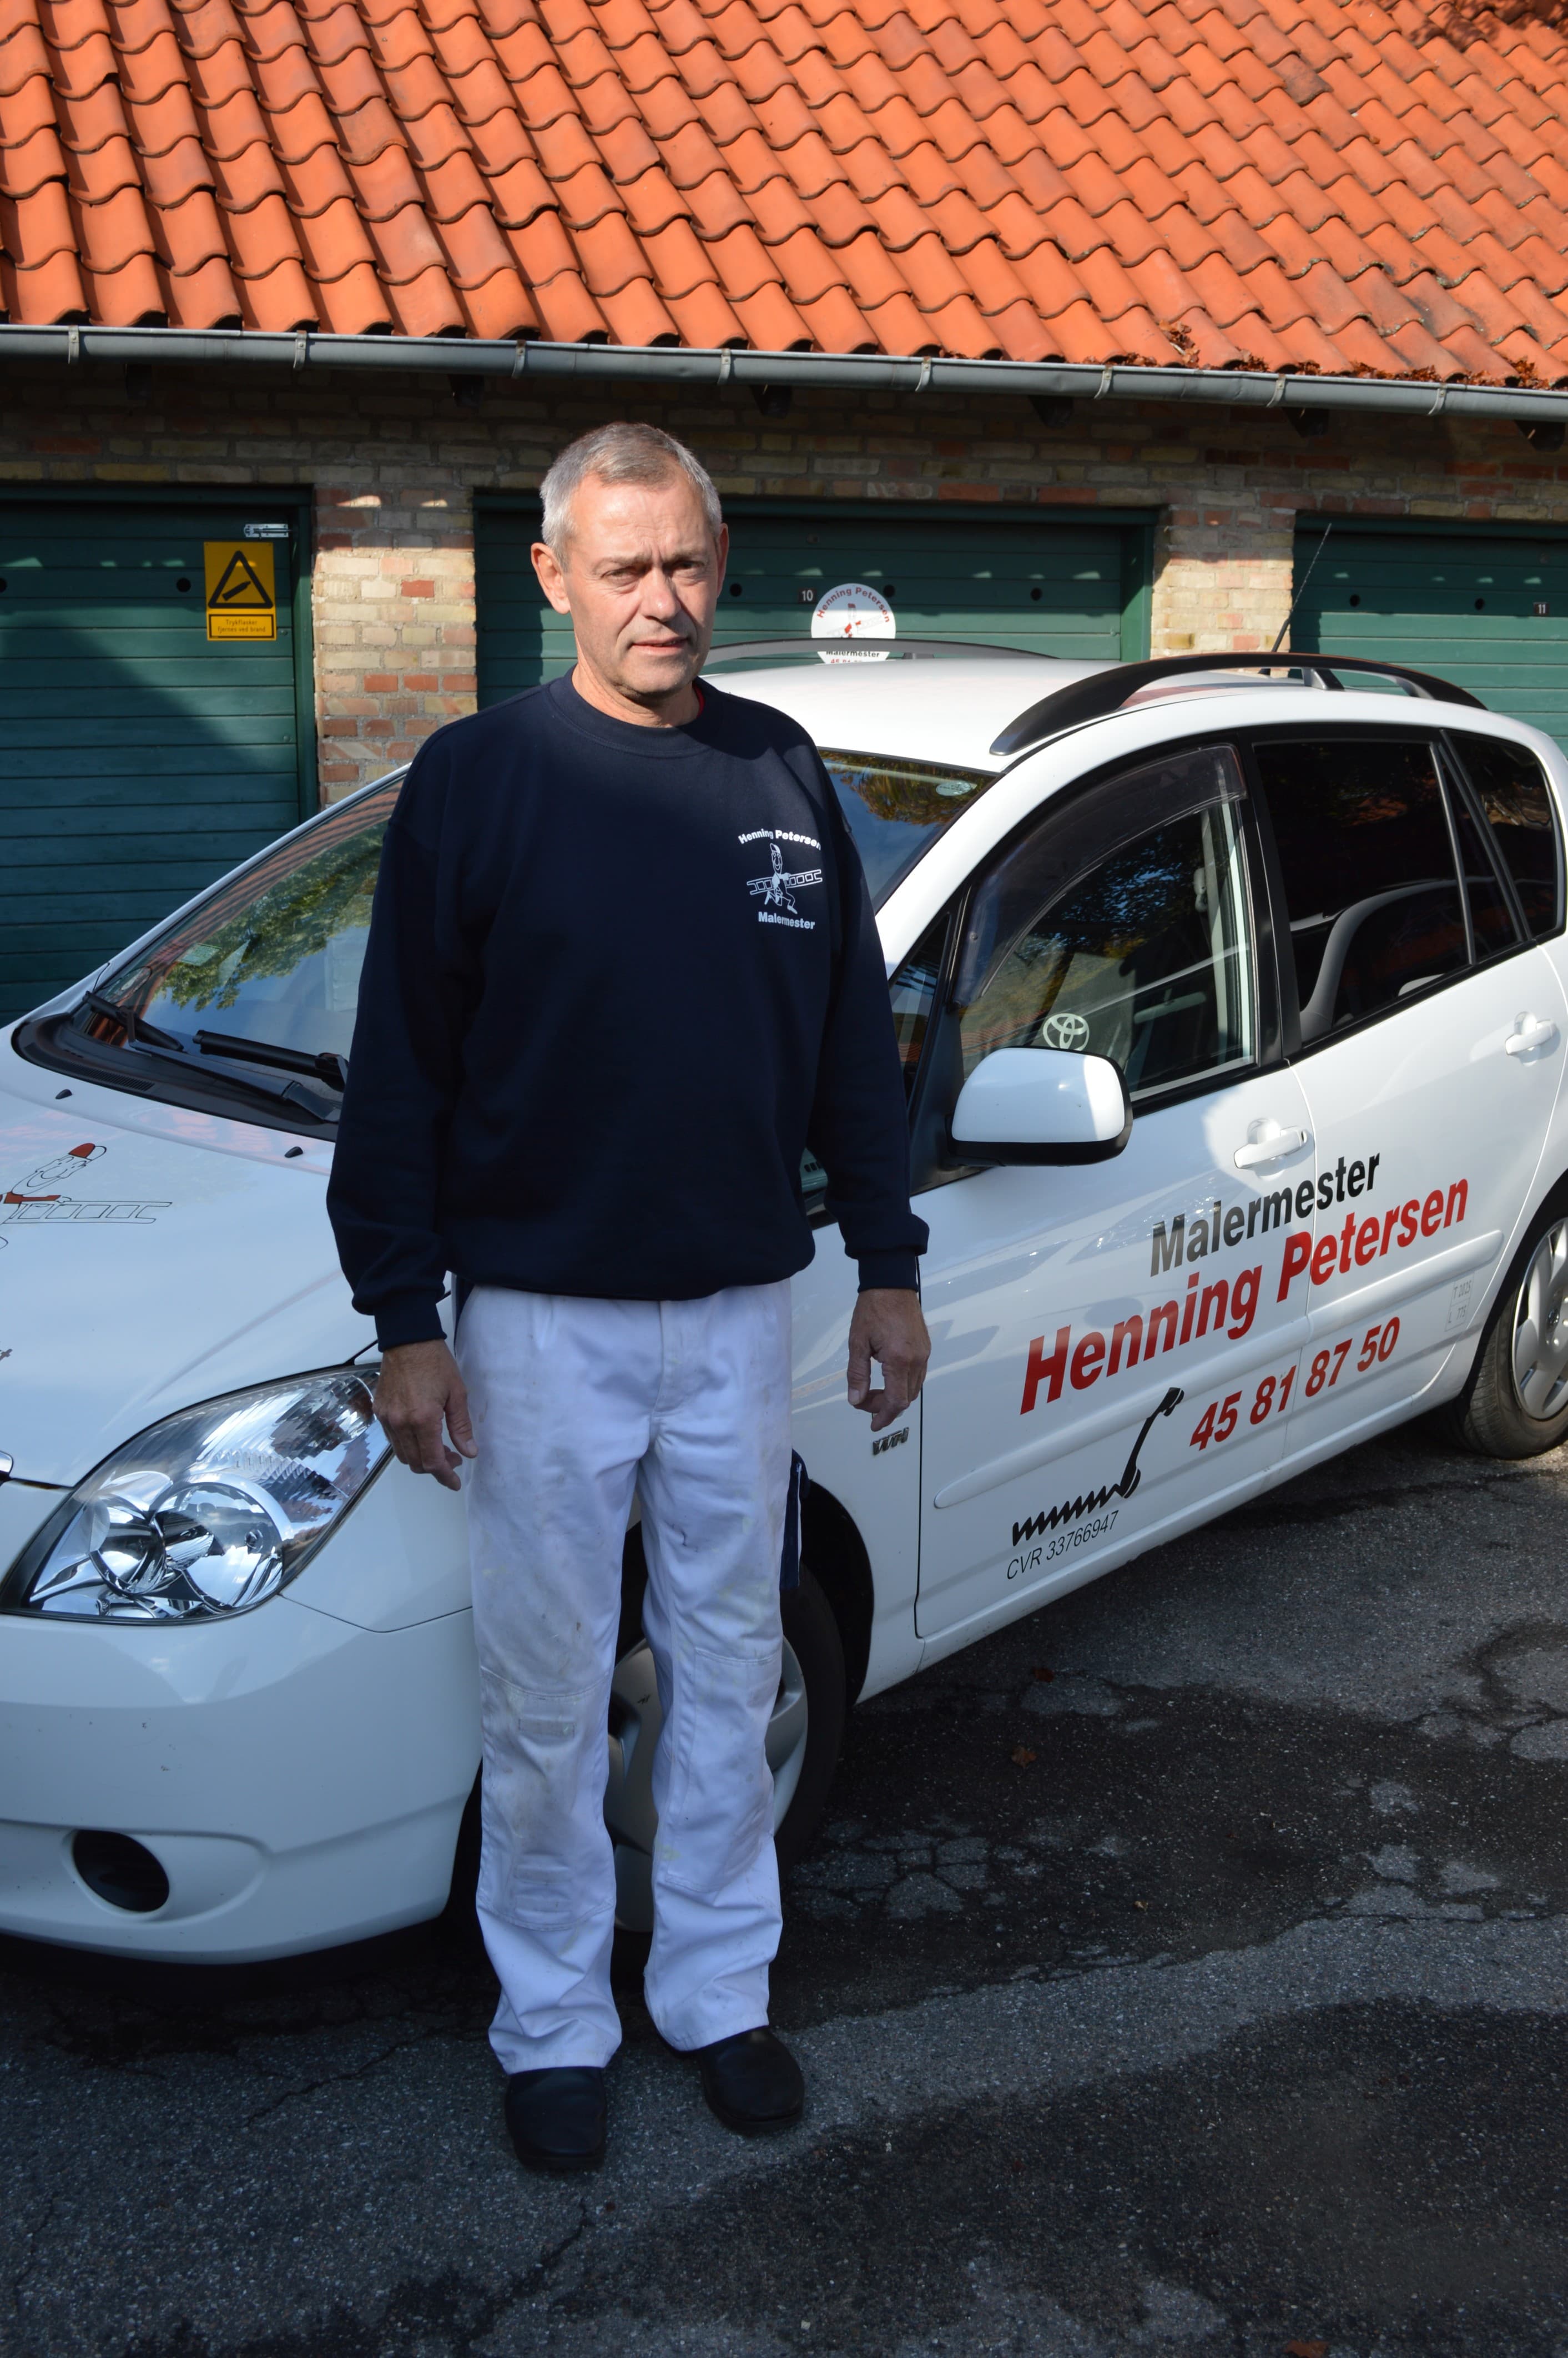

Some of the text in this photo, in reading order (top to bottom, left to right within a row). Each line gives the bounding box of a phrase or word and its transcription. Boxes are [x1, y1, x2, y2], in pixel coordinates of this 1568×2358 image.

[801, 590, 813, 601] 10
[816, 587, 890, 622] Henning Petersen
[1537, 604, 1546, 614] 11
[738, 828, 821, 850] Henning Petersen
[758, 911, 815, 929] Malermester
[1150, 1152, 1380, 1278] Malermester
[1020, 1178, 1469, 1415] Henning Petersen
[1189, 1317, 1400, 1451] 45 81 87 50
[1007, 1509, 1119, 1580] CVR 33766947
